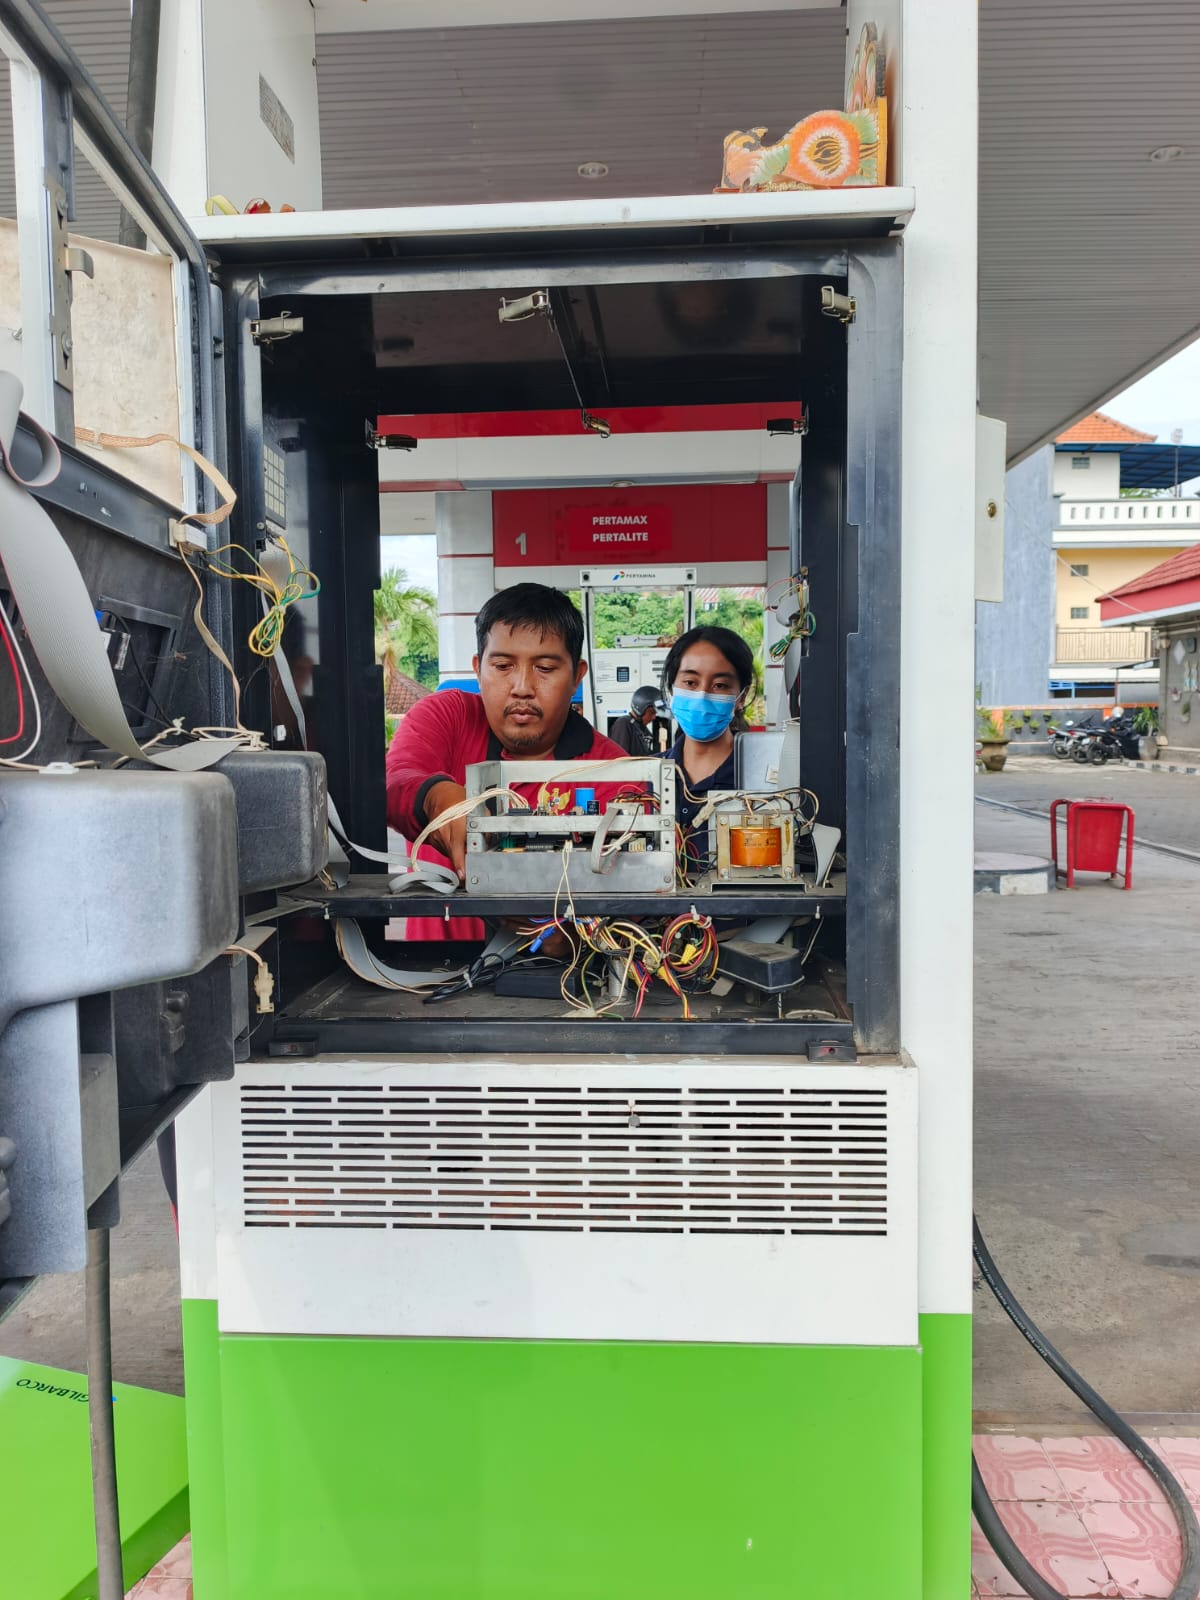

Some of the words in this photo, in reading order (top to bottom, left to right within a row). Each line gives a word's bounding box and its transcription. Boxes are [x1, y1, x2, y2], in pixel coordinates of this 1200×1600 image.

[592, 515, 648, 525] PERTAMAX
[592, 532, 649, 542] PERTALITE
[515, 532, 527, 556] 1
[596, 695, 603, 704] 5
[16, 1378, 89, 1402] GILBARCO
